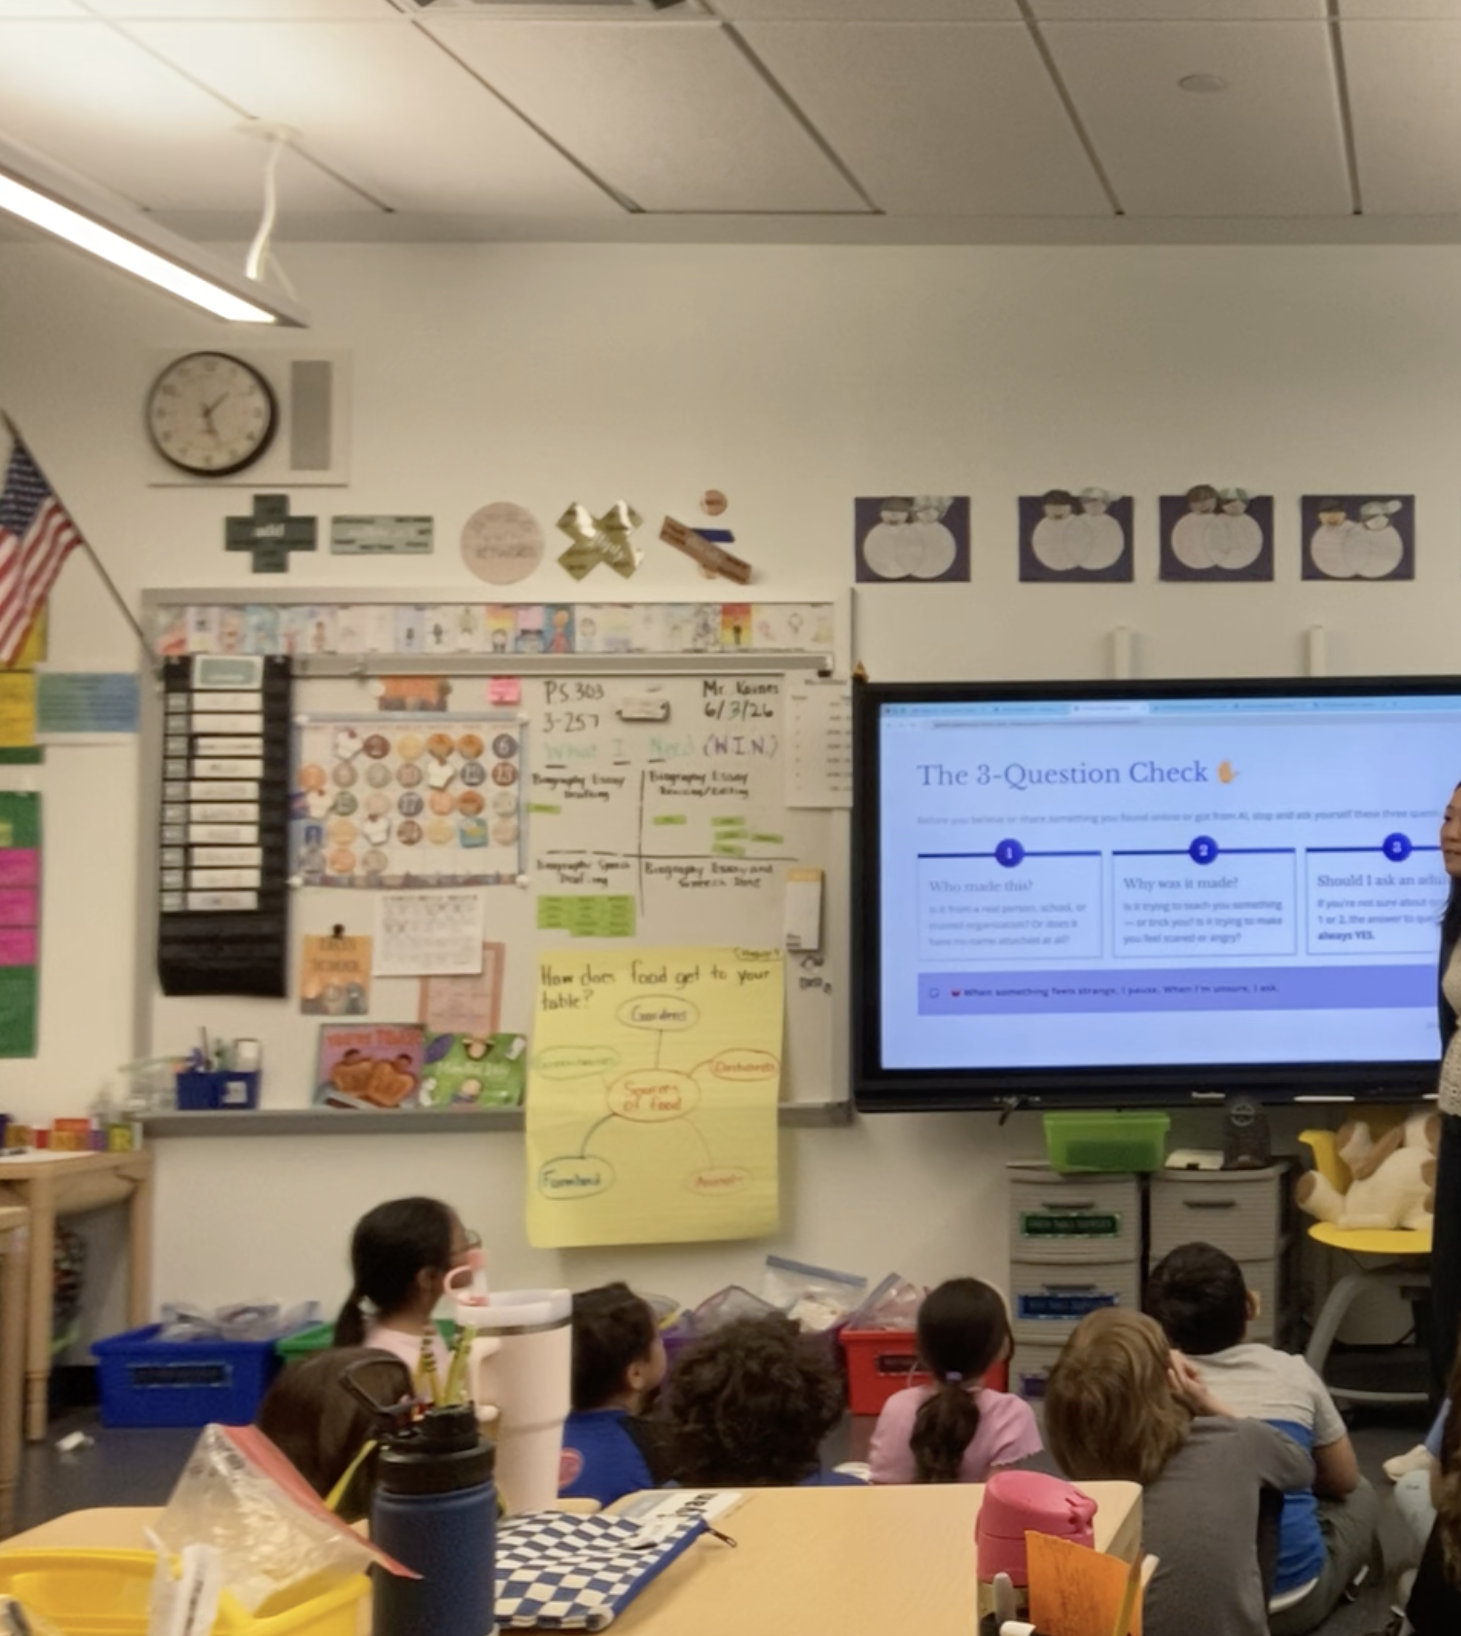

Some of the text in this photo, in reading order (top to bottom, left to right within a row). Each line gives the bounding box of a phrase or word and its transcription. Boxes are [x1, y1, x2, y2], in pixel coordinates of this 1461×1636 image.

[544, 680, 606, 704] PS 303
[704, 699, 774, 720] 6/3/26
[543, 711, 600, 733] 3-257
[916, 760, 1209, 791] The 3-Question Check
[1048, 813, 1099, 826] something
[1314, 809, 1353, 822] yourself
[1199, 843, 1209, 857] 2
[928, 878, 1034, 892] Who made this?
[1122, 875, 1239, 893] Why was it made?
[1316, 873, 1364, 887] Should
[1375, 873, 1396, 886] ask
[1398, 875, 1416, 886] an
[1231, 900, 1283, 912] something
[1317, 929, 1376, 943] always YES.
[541, 963, 575, 987] How
[579, 962, 617, 987] does
[631, 958, 667, 985] food
[674, 964, 700, 991] get
[711, 962, 728, 981] to
[737, 968, 771, 987] your
[541, 988, 595, 1011] table?
[963, 986, 993, 998] When
[995, 986, 1049, 999] something
[1051, 985, 1076, 996] feels
[1162, 983, 1193, 994] When
[623, 1096, 682, 1112] of food
